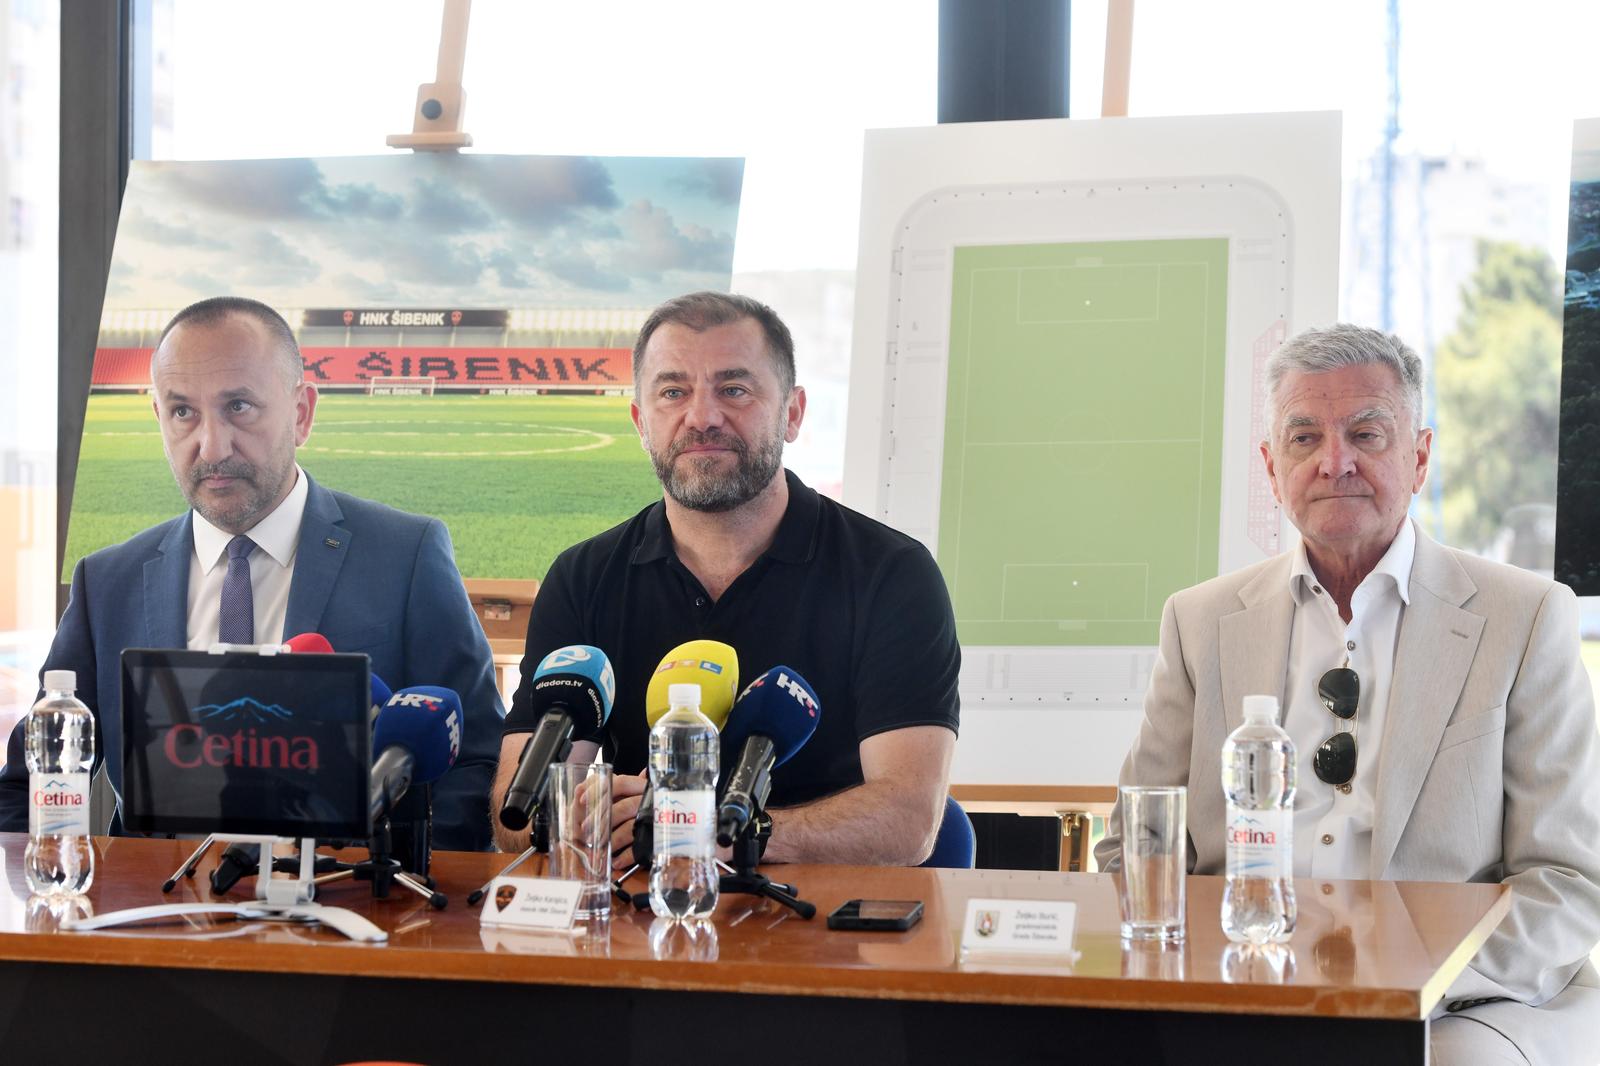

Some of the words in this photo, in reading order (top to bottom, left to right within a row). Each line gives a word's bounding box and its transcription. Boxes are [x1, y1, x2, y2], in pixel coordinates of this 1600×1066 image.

[359, 312, 389, 326] HNK
[391, 310, 446, 326] ŠIBENIK
[355, 351, 617, 381] ŠIBENIK
[535, 679, 583, 690] diadora.tv
[776, 672, 819, 717] HRT
[386, 692, 444, 712] HRT
[163, 722, 320, 770] Cetina
[33, 790, 82, 806] Cetina
[653, 806, 697, 824] Cetina
[1227, 825, 1277, 845] Cetina
